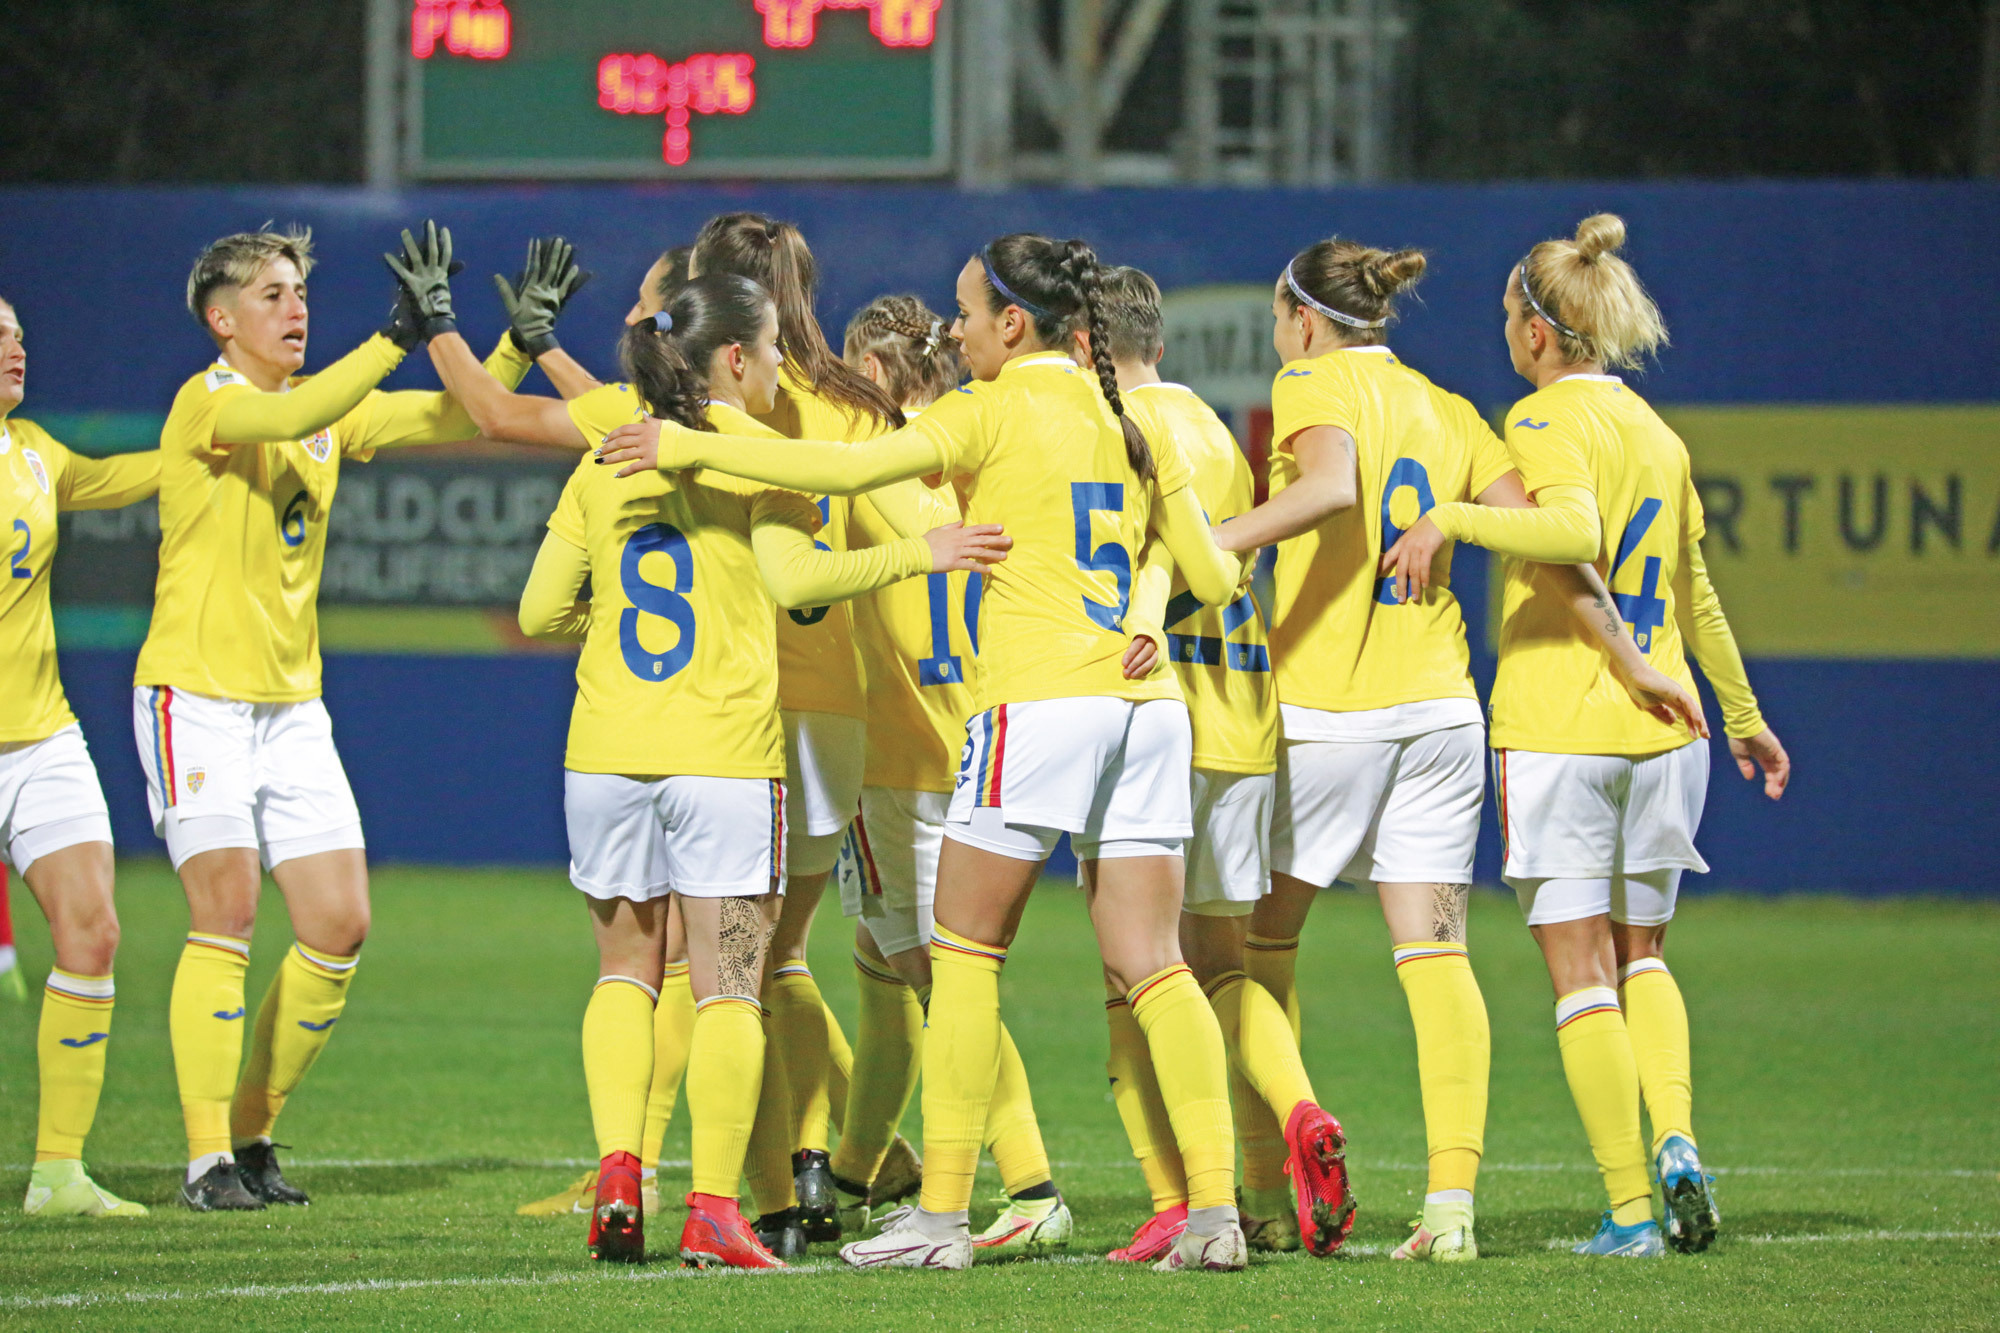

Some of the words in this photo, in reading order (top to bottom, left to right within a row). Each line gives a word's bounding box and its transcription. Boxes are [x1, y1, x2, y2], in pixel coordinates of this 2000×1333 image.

[11, 518, 33, 579] 2
[281, 490, 306, 547] 6
[1071, 482, 1131, 635] 5
[1693, 474, 2000, 554] RTUN
[619, 522, 697, 682] 8
[1608, 497, 1666, 655] 4
